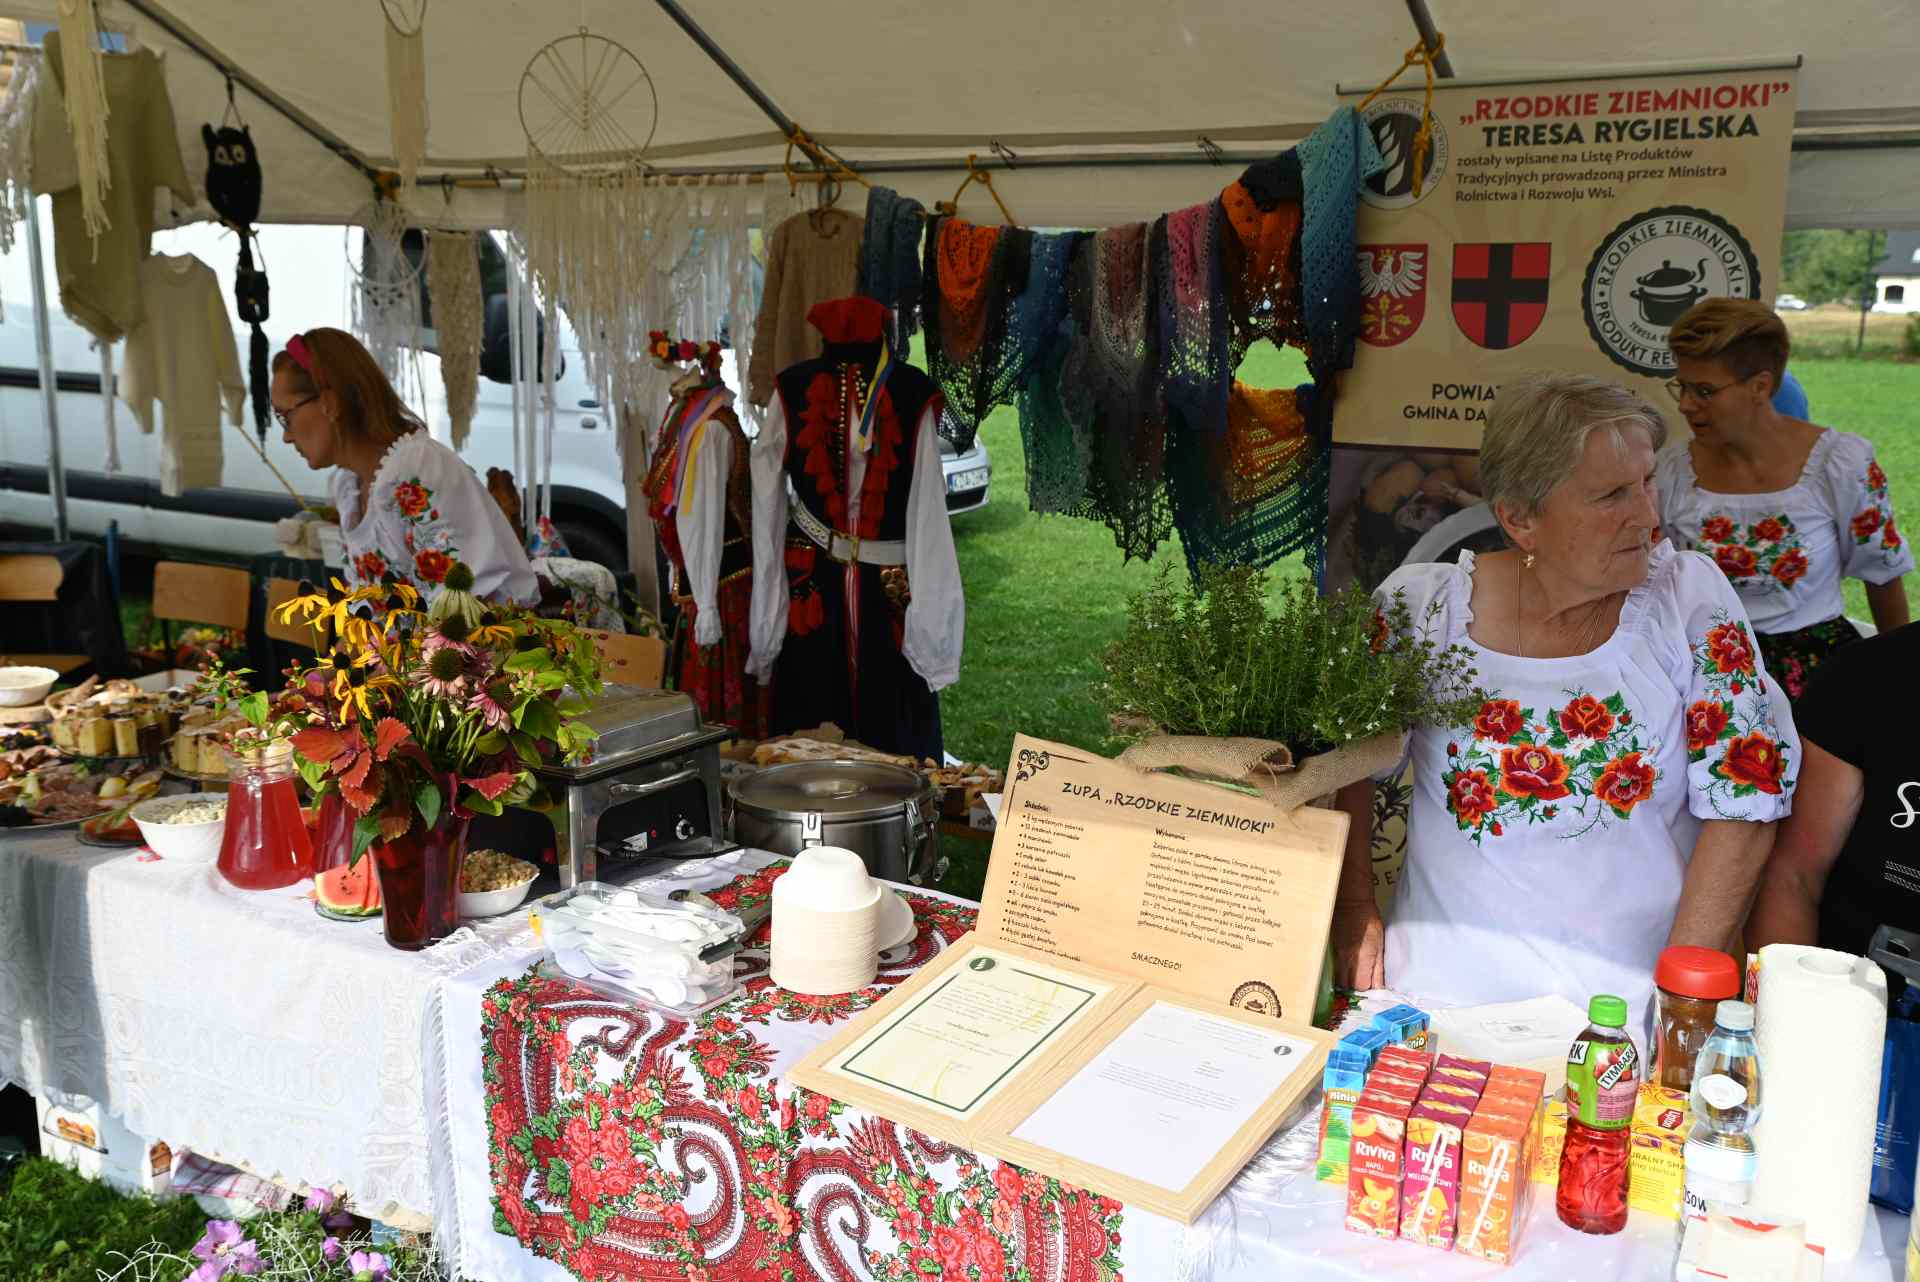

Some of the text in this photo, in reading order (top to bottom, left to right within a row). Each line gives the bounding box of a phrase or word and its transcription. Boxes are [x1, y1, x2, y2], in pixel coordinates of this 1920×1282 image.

[1459, 82, 1790, 125] „RZODKIE ZIEMNIOKI”
[1482, 113, 1759, 147] TERESA RYGIELSKA
[1456, 147, 1693, 168] zostały wpisane na Listę Produktów
[1456, 165, 1727, 187] Tradycyjnych prowadzoną przez Ministra
[1455, 187, 1615, 202] Rolnictwa i Rozwoju Wsi.
[1597, 220, 1745, 286] RZODKIE ZIEMNIOKI
[1595, 301, 1649, 361] PRODUKT
[1403, 405, 1459, 420] GMINA
[1062, 782, 1101, 800] ZUPA
[1105, 792, 1181, 816] „RZODKIE
[1131, 951, 1182, 970] SMACZNEGO!
[1600, 1045, 1635, 1086] TYMBARK
[1355, 1141, 1397, 1163] Riviva
